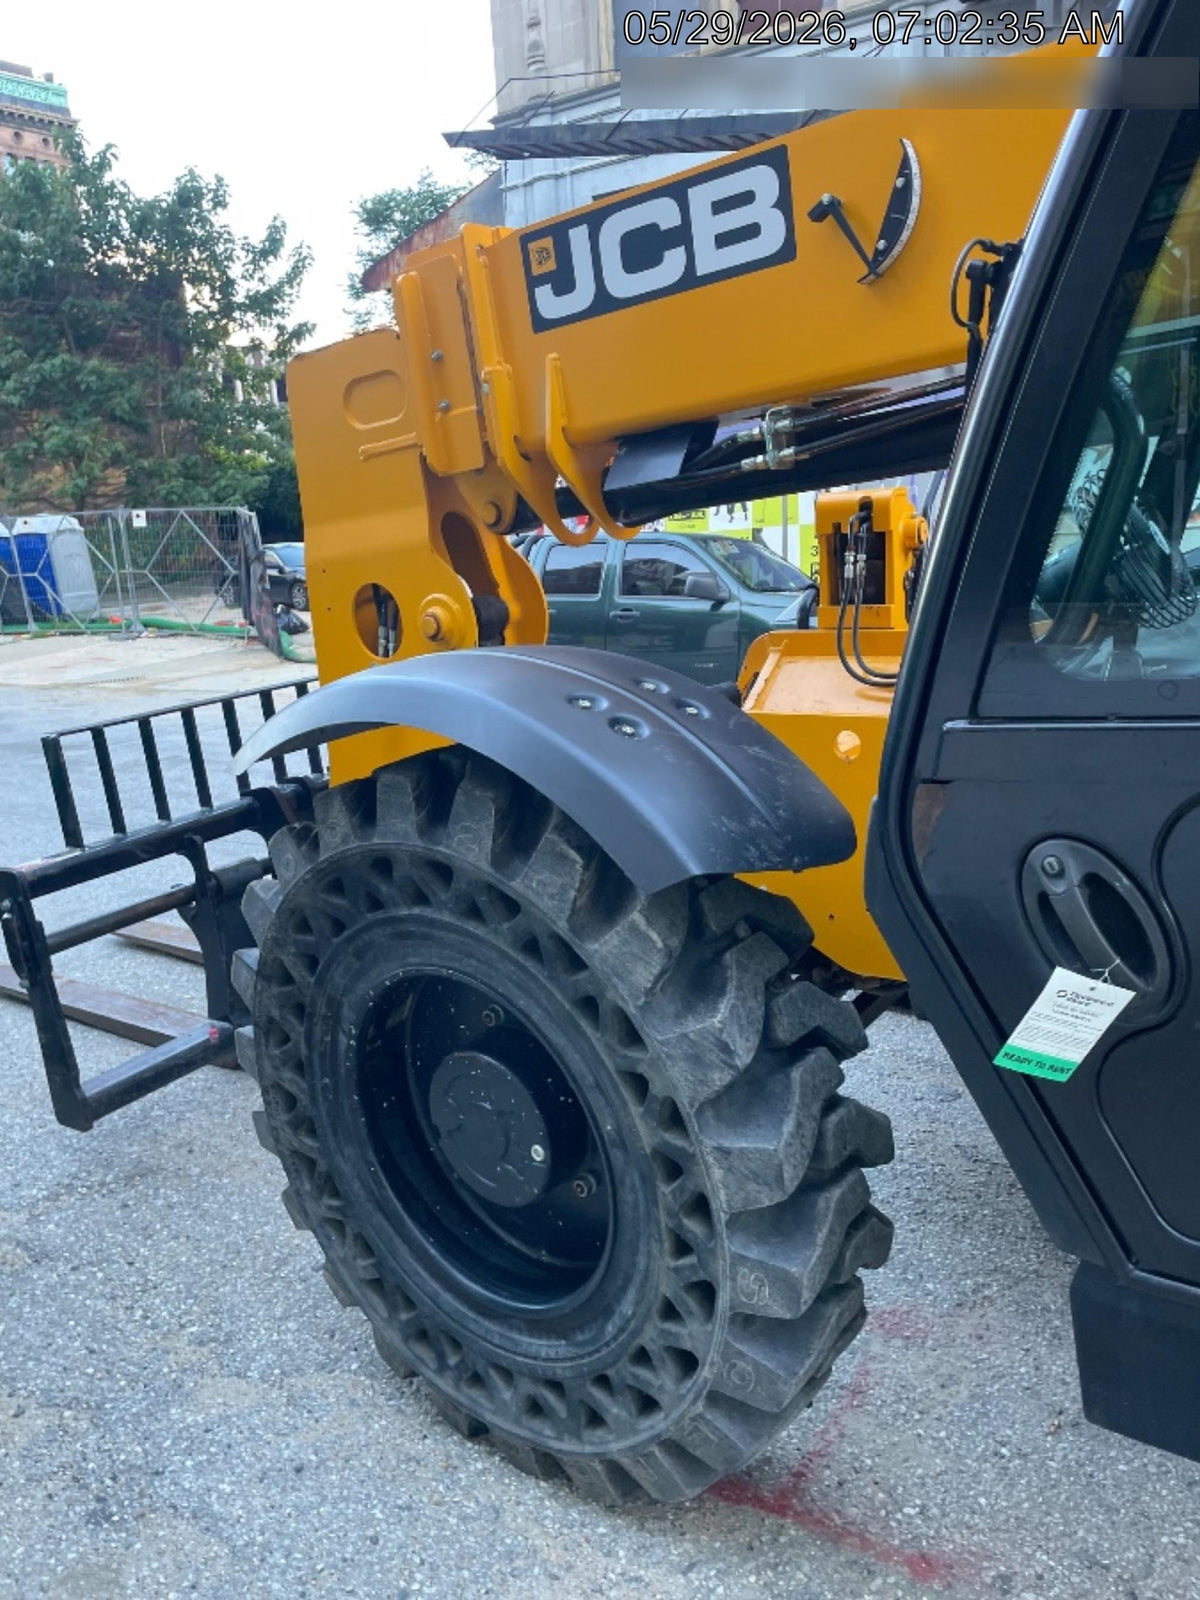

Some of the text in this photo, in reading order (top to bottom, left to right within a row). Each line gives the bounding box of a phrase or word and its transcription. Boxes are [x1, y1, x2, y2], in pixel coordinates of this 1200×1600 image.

[534, 164, 787, 320] JCB
[1002, 1051, 1073, 1075] READY TO RENT
